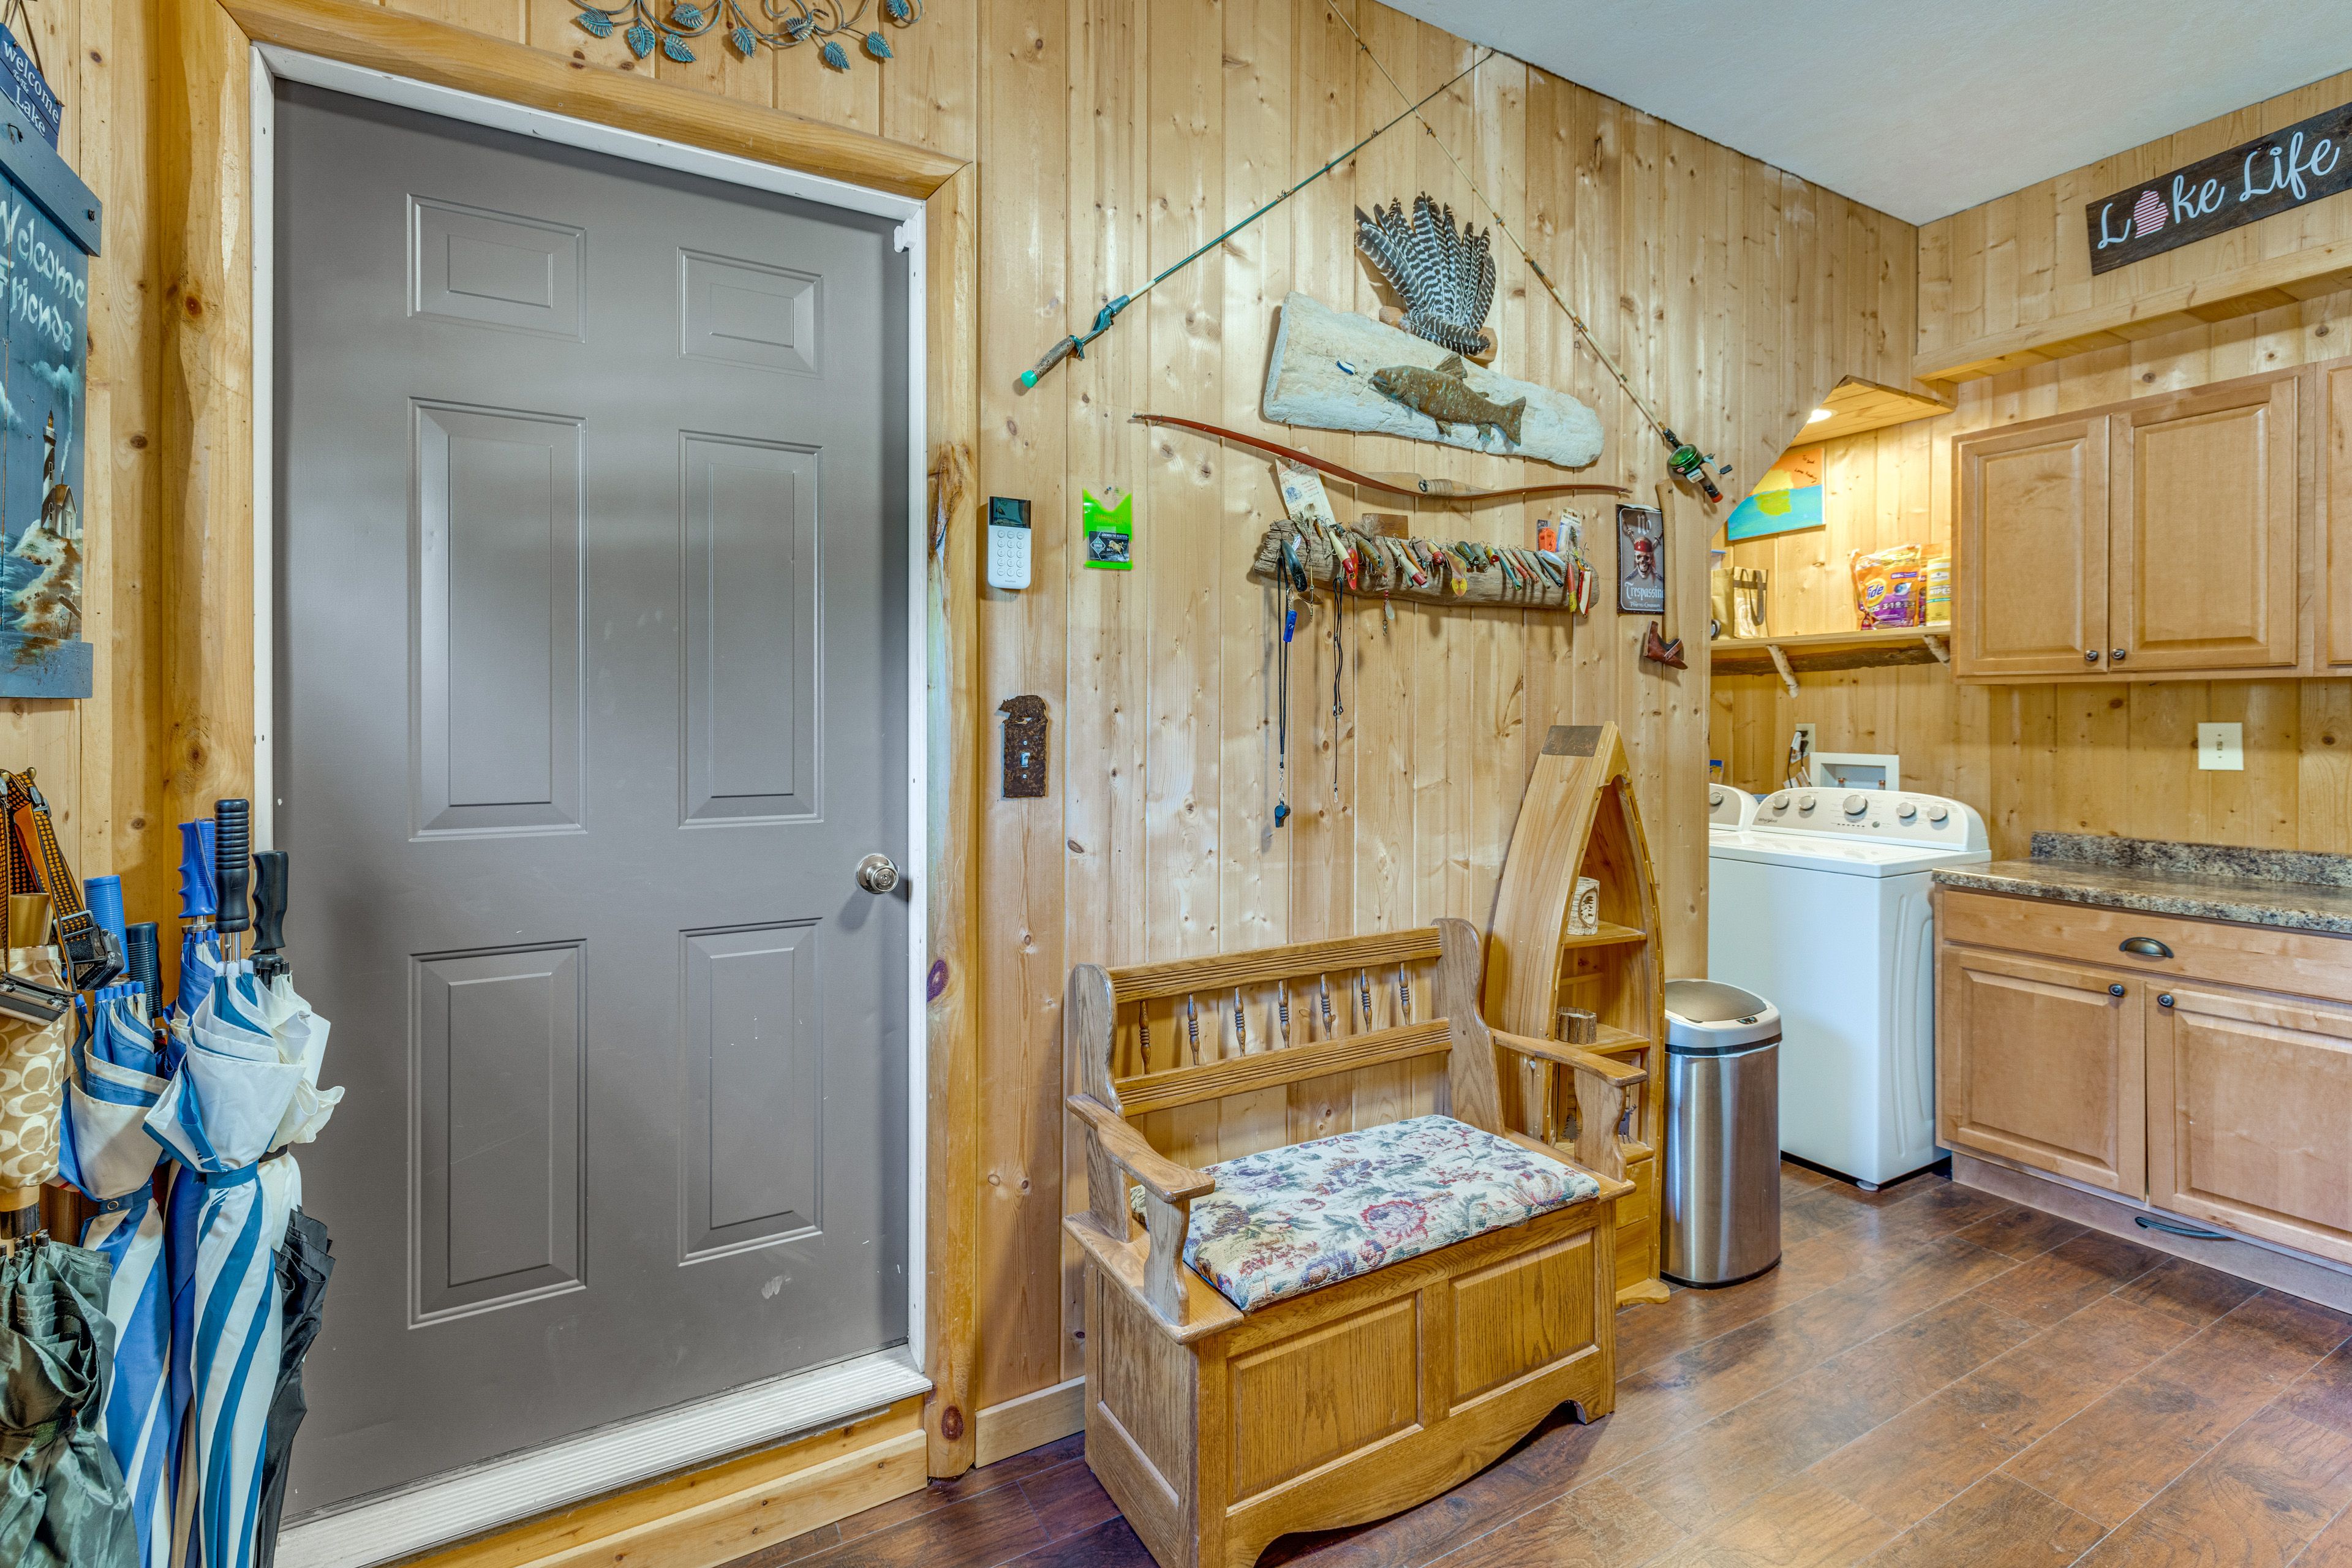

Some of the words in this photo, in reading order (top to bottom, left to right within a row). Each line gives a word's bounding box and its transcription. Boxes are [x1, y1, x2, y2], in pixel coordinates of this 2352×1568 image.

[13, 69, 20, 82] To
[20, 78, 29, 94] The
[16, 85, 46, 137] Lake
[2097, 175, 2225, 250] Lke
[2239, 131, 2340, 202] Life
[1637, 514, 1652, 535] No
